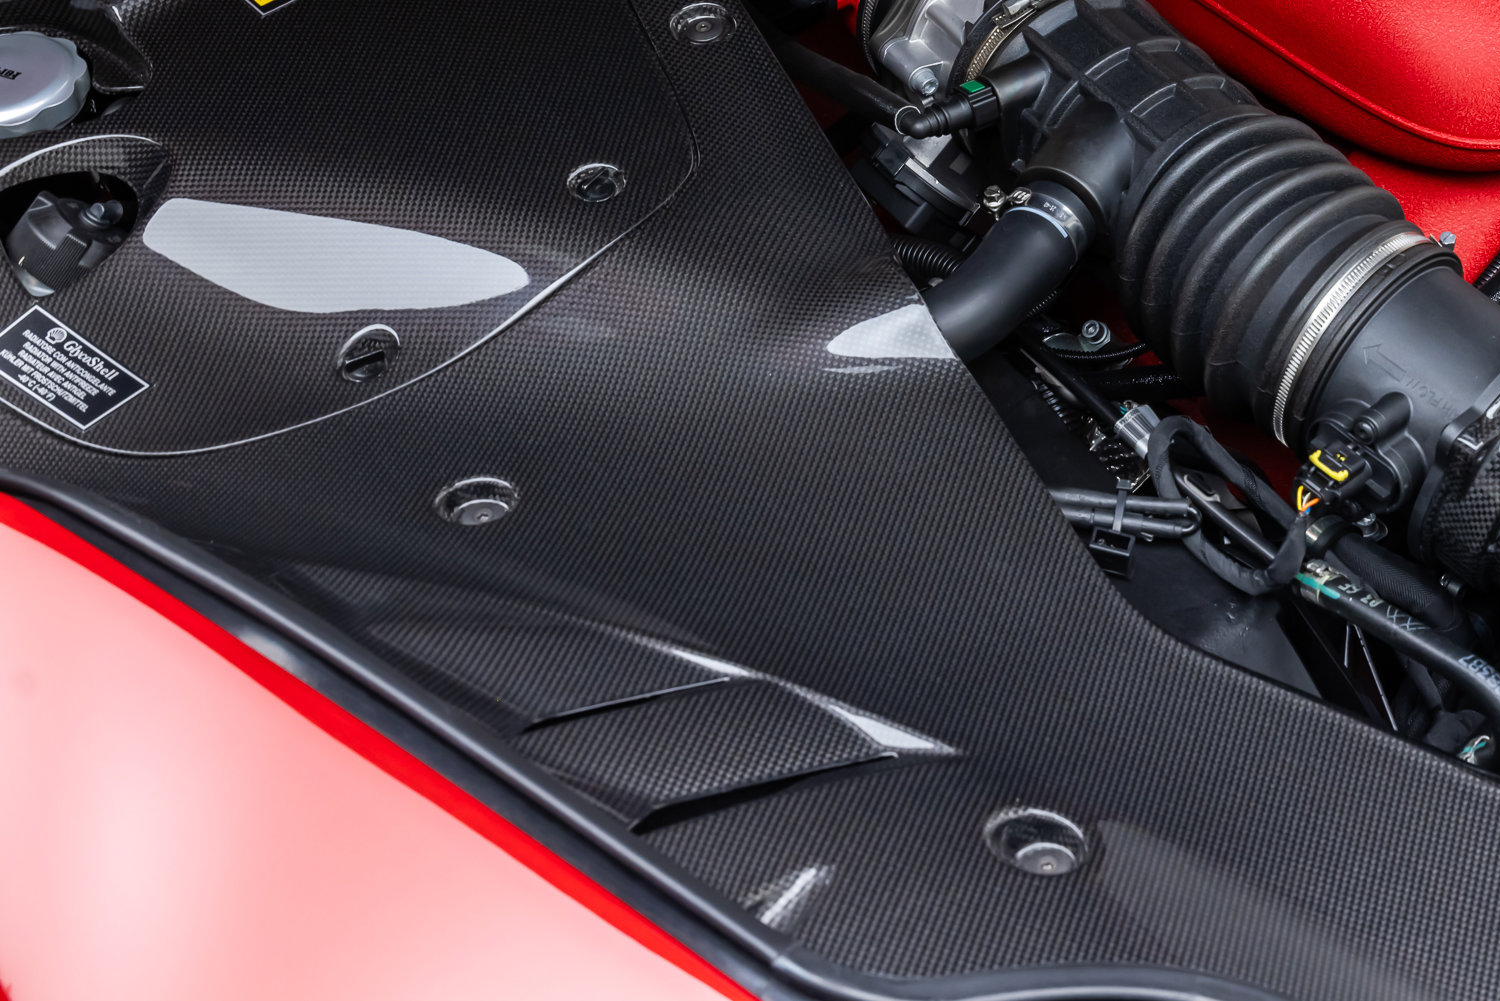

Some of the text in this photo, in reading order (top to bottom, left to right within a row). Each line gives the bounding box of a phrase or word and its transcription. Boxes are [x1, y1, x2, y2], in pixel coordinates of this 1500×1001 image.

[18, 350, 86, 400] RADIATEUR AVEC ANTIGEL
[22, 329, 116, 396] RADIATORE CON ANTICONGELANTE
[23, 341, 99, 396] RADIATOR WITH ANTIFREEZE
[64, 340, 119, 380] GlycoShell
